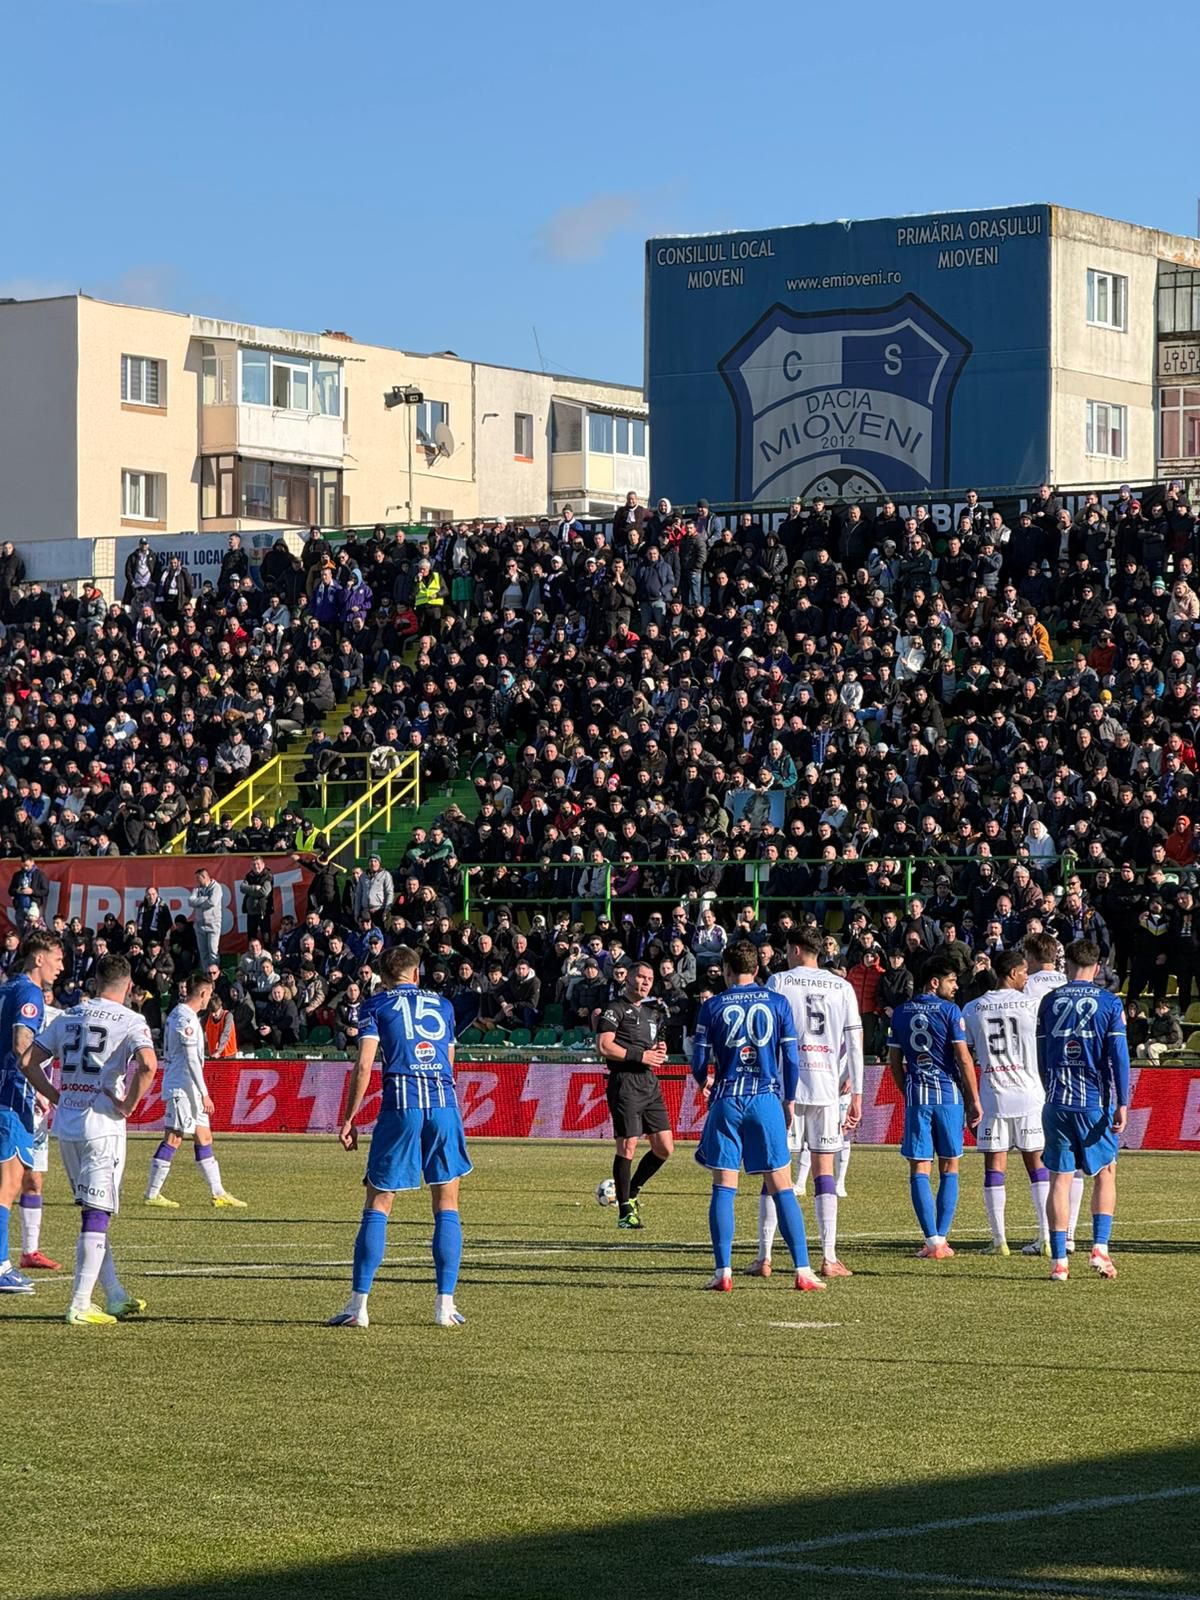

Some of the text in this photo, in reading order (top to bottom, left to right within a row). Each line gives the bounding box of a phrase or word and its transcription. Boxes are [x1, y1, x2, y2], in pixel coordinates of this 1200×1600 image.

[656, 239, 776, 266] CONSILIUL LOCAL
[897, 221, 964, 246] PRIMĂRIA
[937, 246, 999, 270] MIOVENI
[687, 267, 744, 289] MIOVENI
[786, 270, 902, 291] www.emioveni.ro
[782, 343, 903, 382] C S
[806, 389, 873, 414] DACIA
[758, 411, 924, 463] MIOVENI
[820, 435, 856, 450] 2012
[391, 995, 447, 1041] 15
[722, 1003, 773, 1048] 20
[909, 1013, 933, 1053] 8
[986, 1017, 1019, 1056] 21
[1051, 996, 1099, 1038] 22
[62, 1022, 107, 1073] 22
